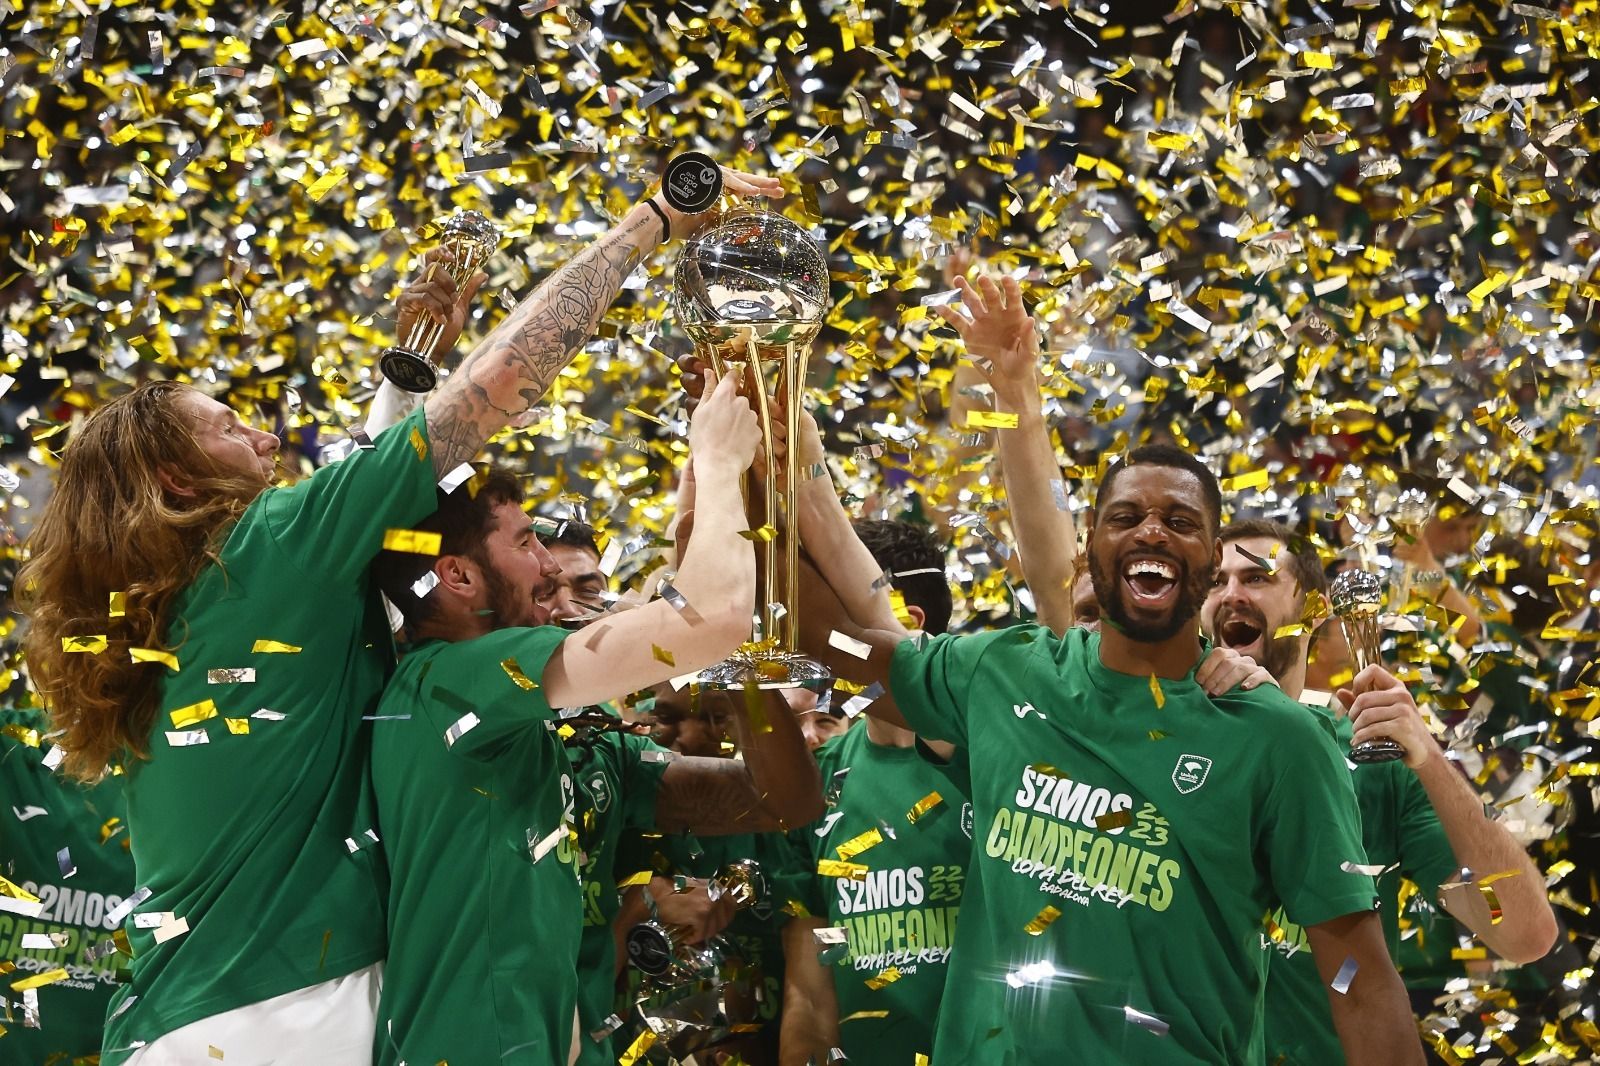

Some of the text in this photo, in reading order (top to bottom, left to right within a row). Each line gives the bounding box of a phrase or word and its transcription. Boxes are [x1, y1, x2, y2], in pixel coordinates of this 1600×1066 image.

[1129, 821, 1168, 846] 23
[986, 808, 1180, 912] CAMPEONES
[1012, 857, 1134, 909] COPA DEL REY
[1040, 882, 1090, 907] BADALONA
[917, 946, 952, 964] REY
